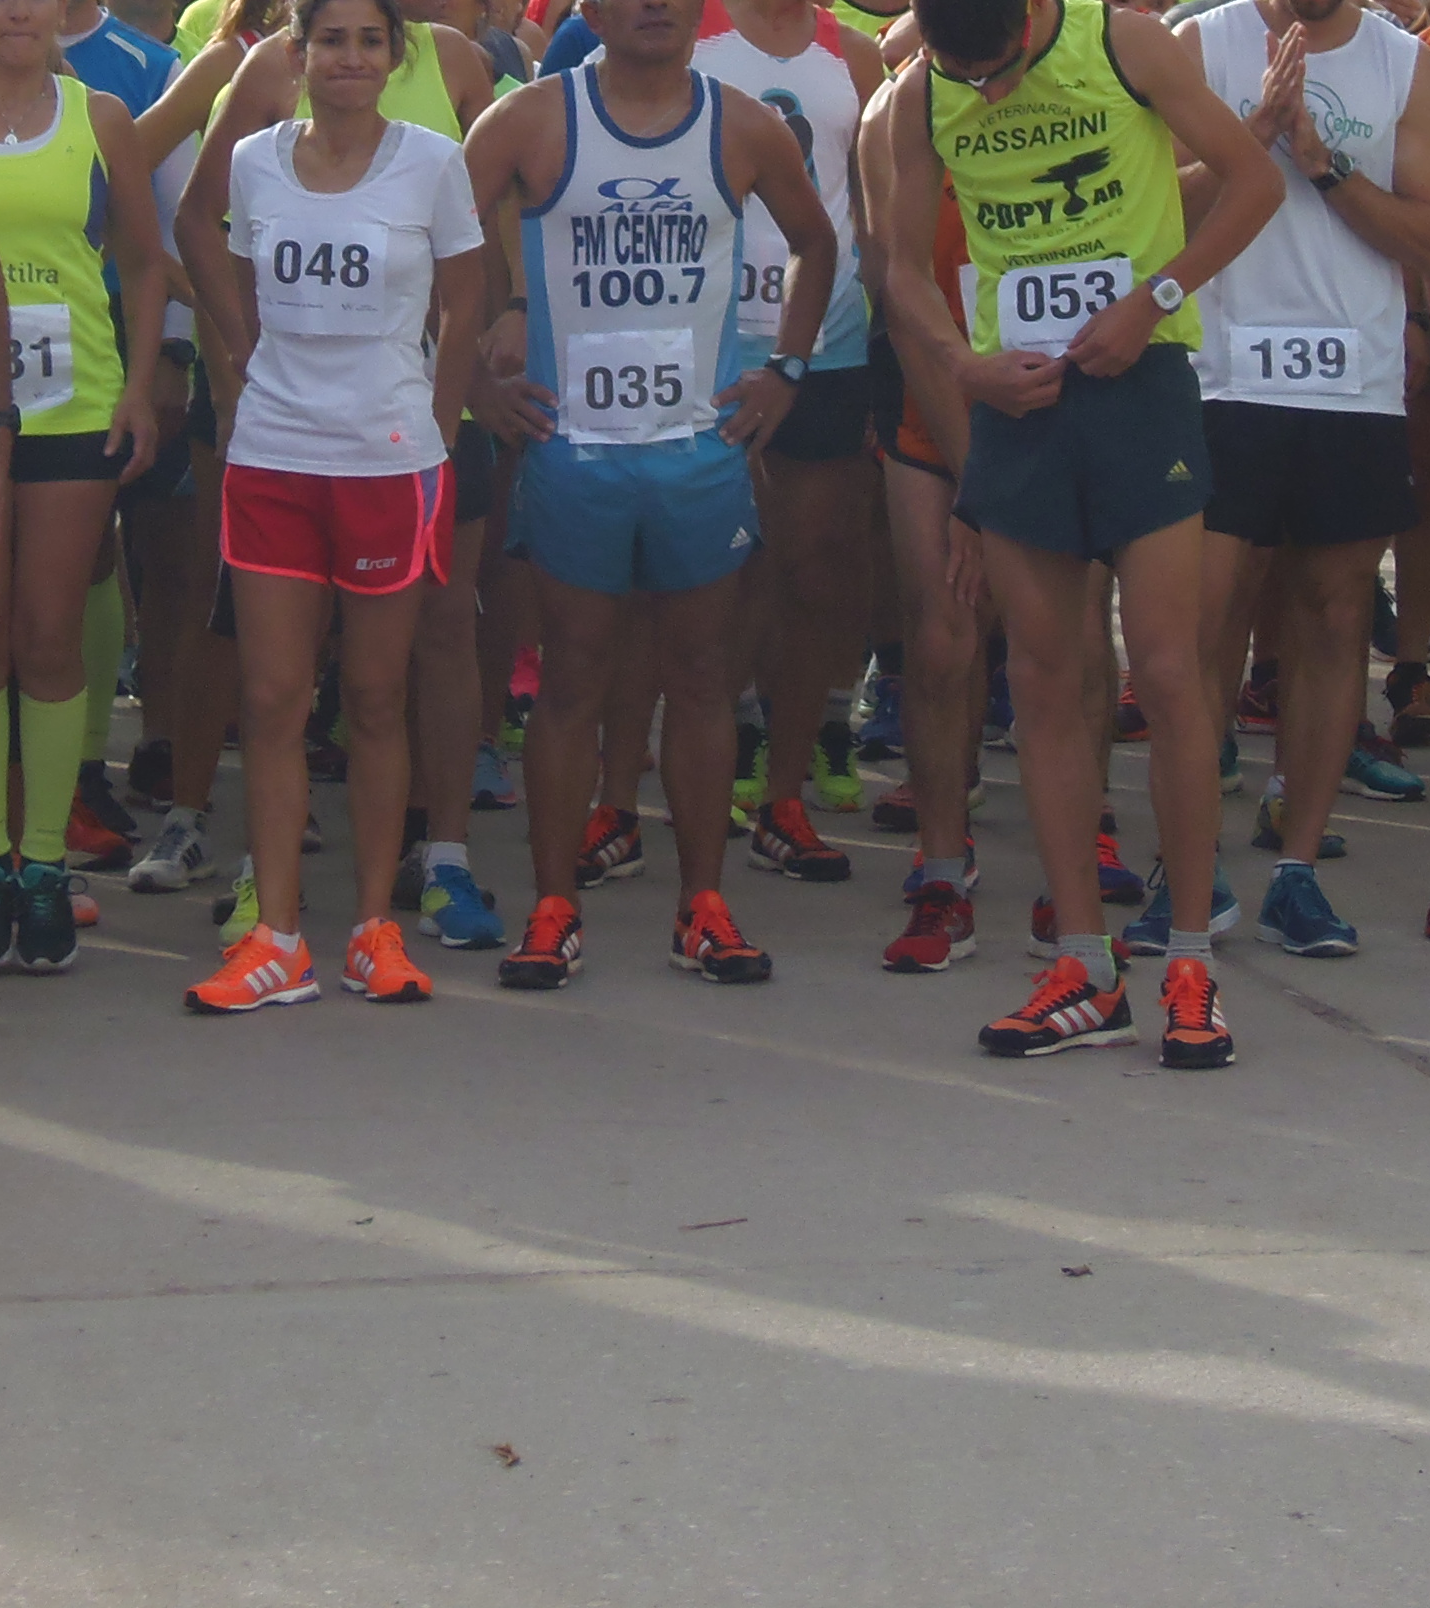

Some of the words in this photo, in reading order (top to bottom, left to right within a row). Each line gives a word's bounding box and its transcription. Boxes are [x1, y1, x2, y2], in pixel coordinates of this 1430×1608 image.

[955, 110, 1108, 158] PASSARINI
[978, 102, 1072, 129] VETERINARIA
[976, 197, 1055, 231] COPY
[571, 214, 607, 266] FM
[614, 213, 708, 266] CENTRO
[1002, 239, 1106, 268] VETERINARIA
[272, 239, 371, 290] 048
[572, 266, 706, 309] 100.7
[1016, 269, 1118, 323] 053
[1249, 336, 1347, 380] 139
[584, 363, 683, 410] 035
